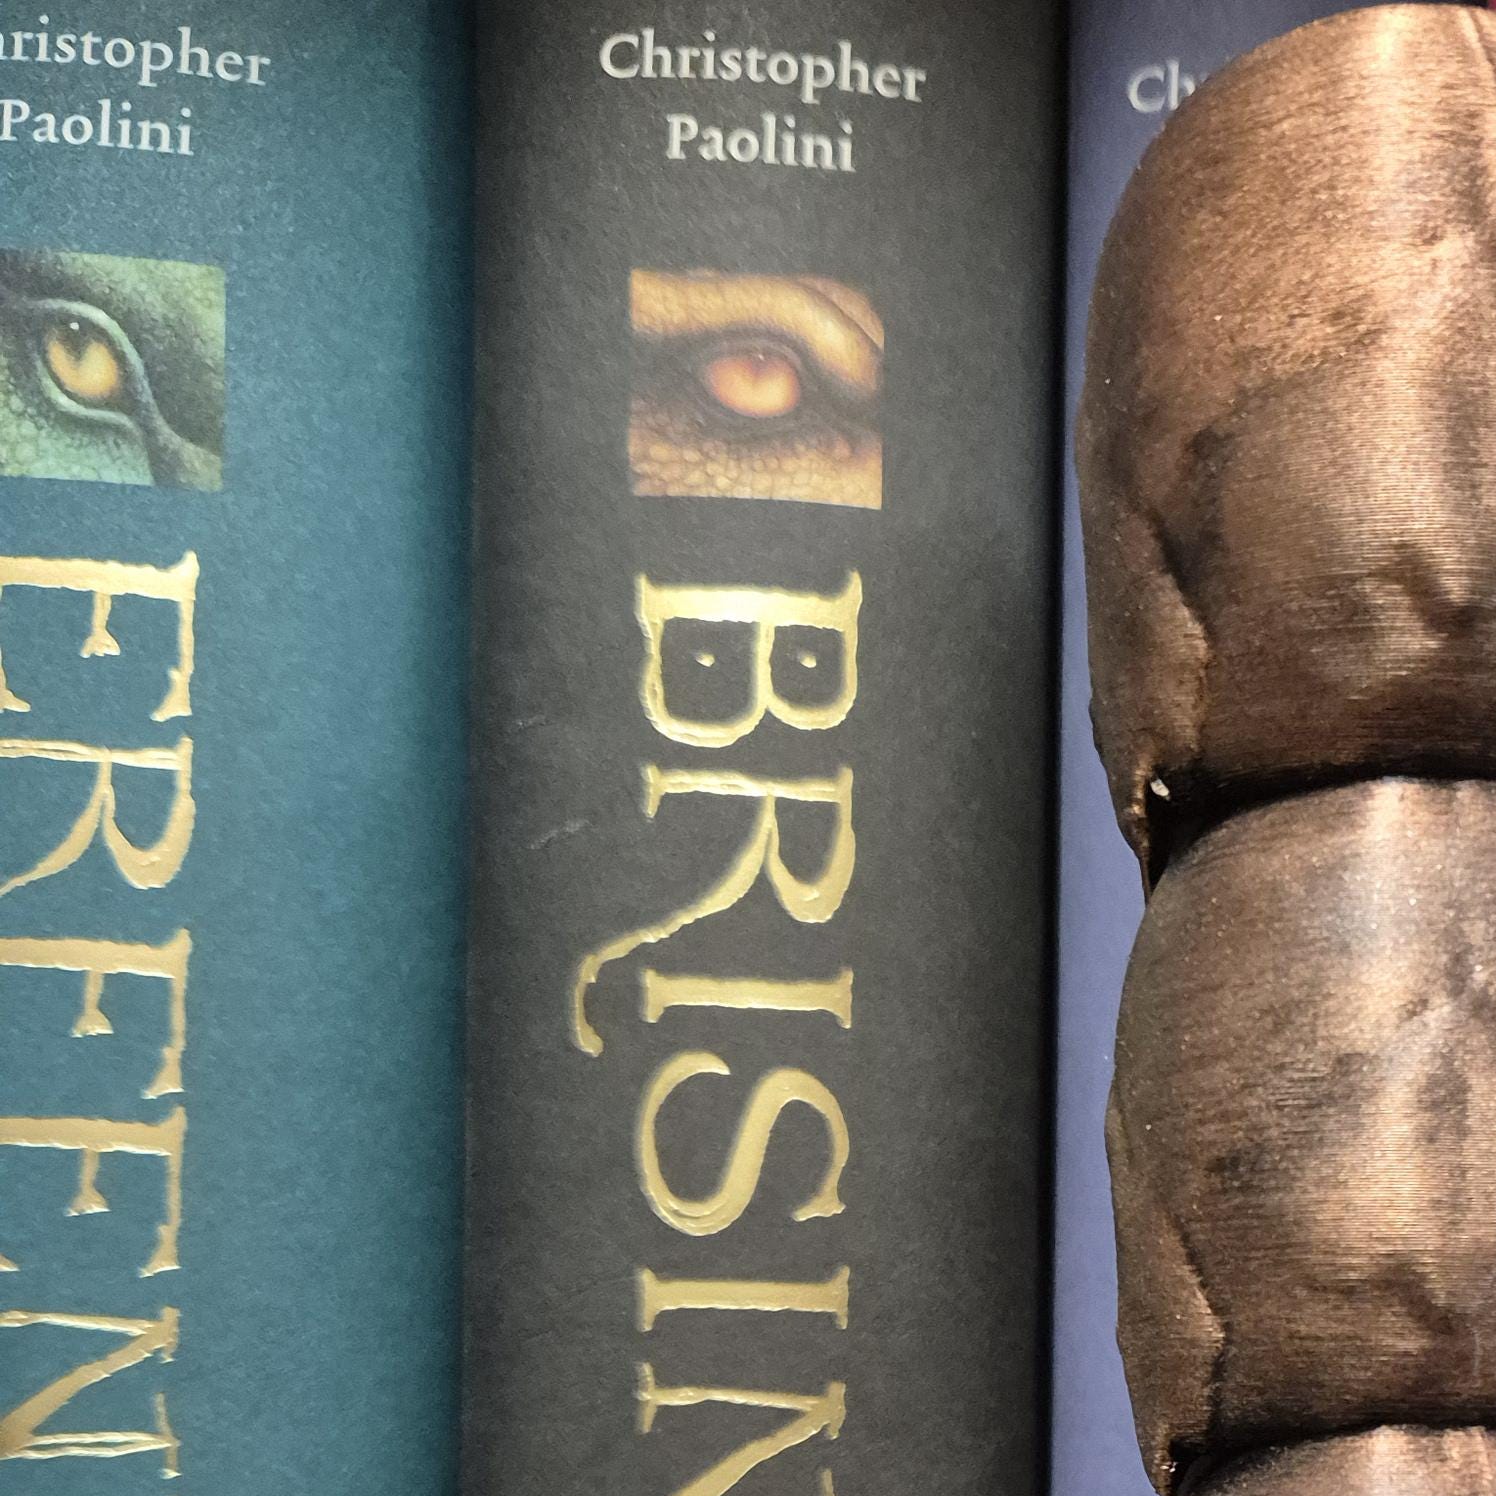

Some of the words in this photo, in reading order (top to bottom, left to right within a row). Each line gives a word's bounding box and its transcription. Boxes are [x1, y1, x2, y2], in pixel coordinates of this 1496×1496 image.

[0, 15, 271, 87] ristopher
[600, 27, 927, 104] Christopher
[0, 98, 194, 156] Paolini
[665, 111, 855, 172] Paolini
